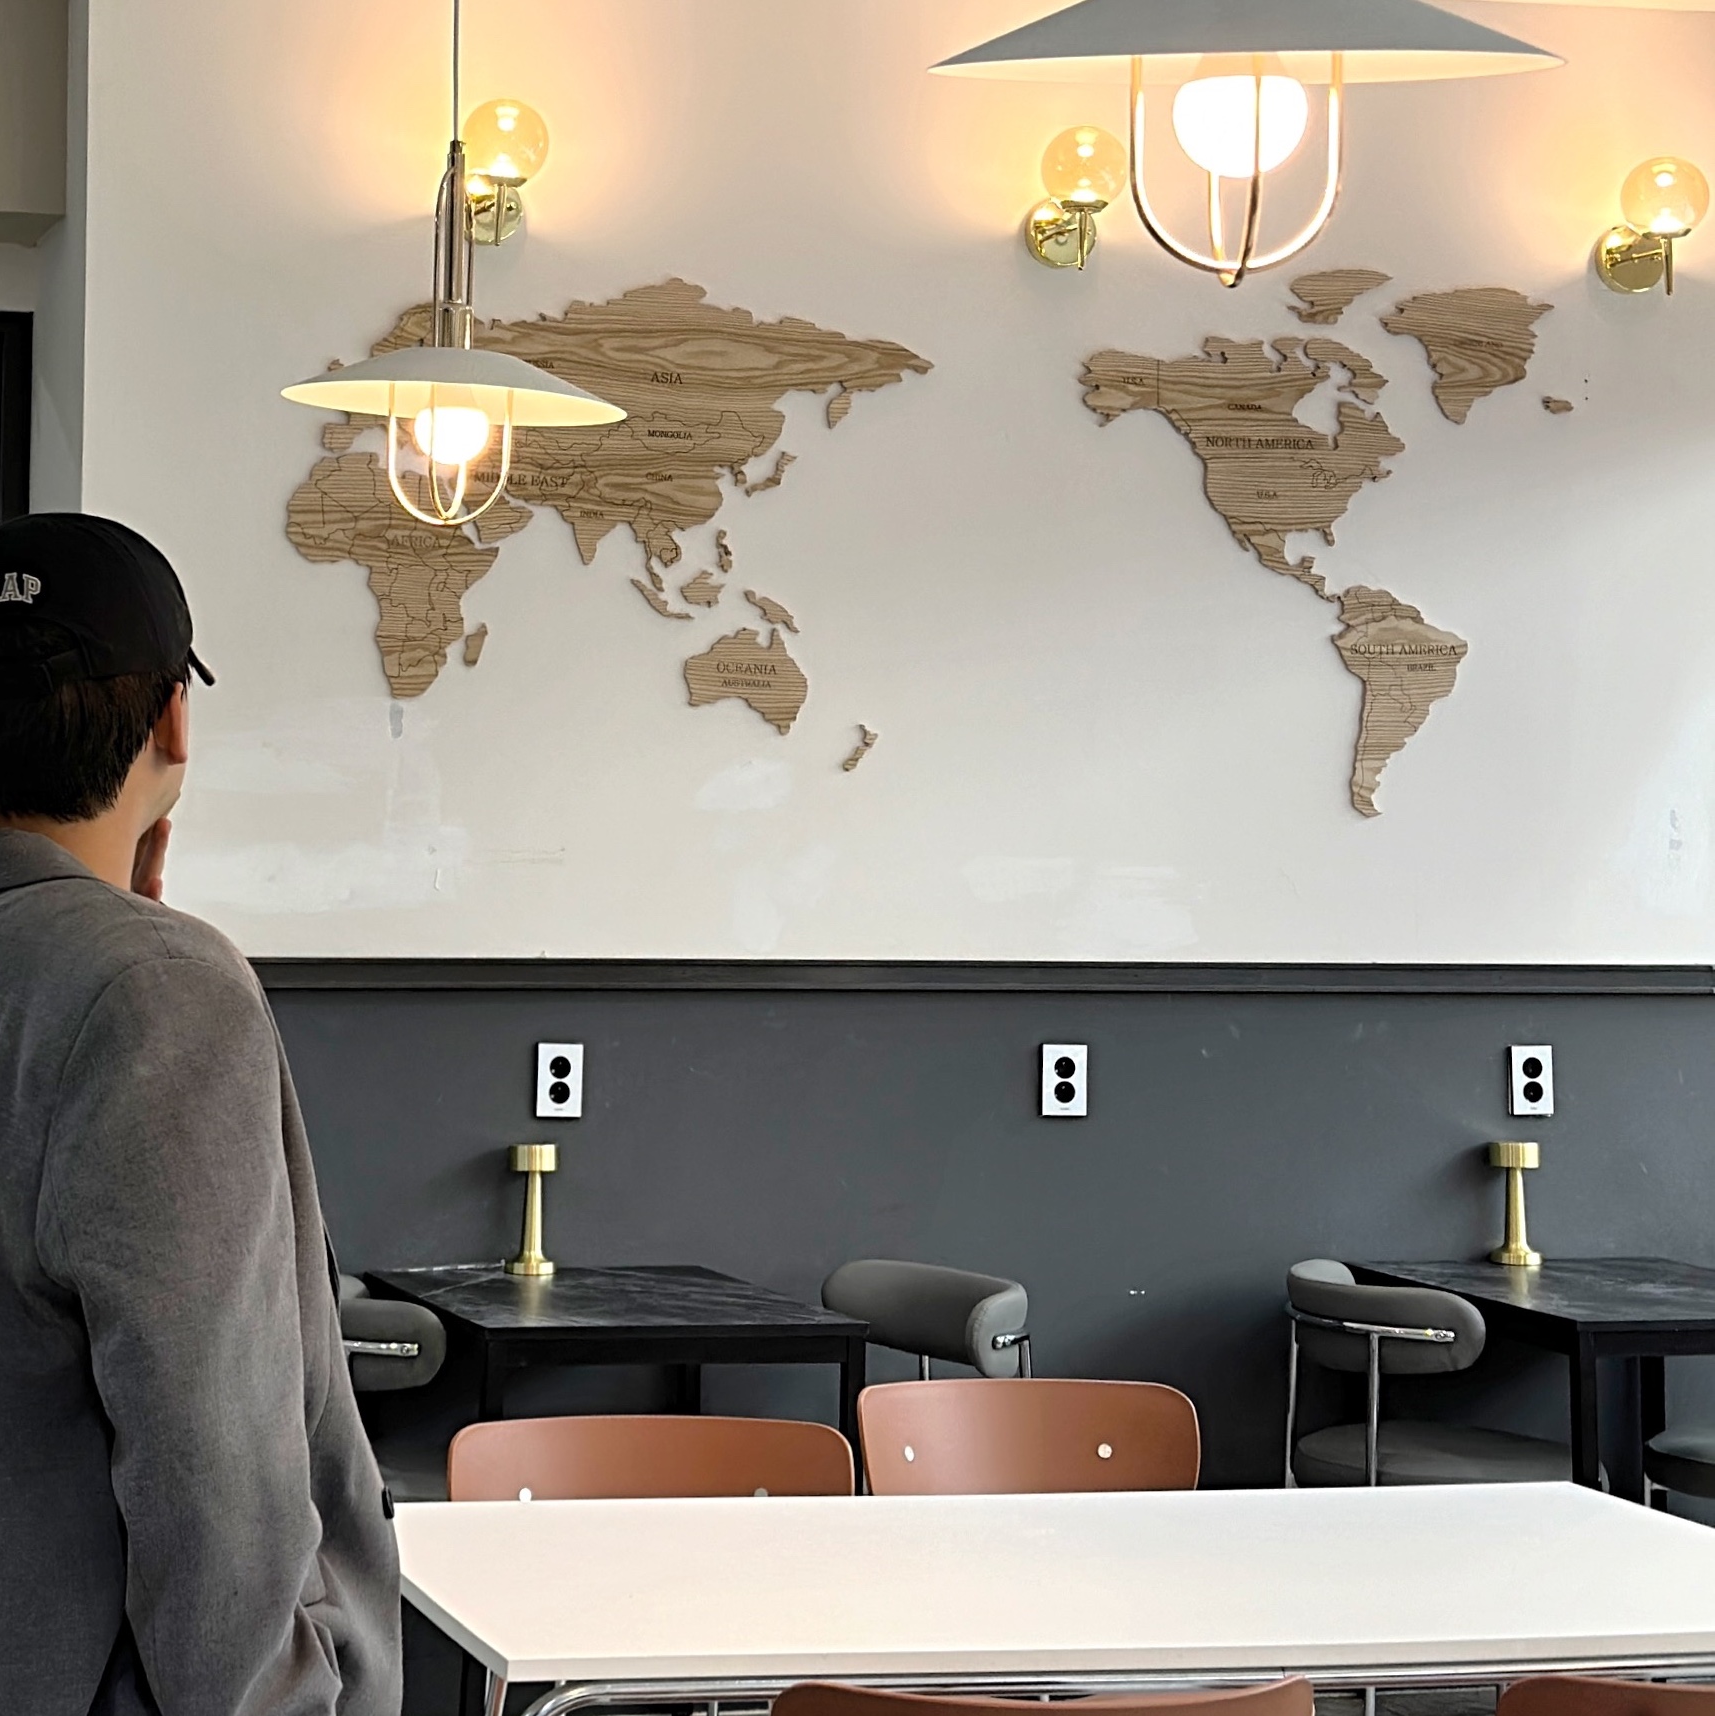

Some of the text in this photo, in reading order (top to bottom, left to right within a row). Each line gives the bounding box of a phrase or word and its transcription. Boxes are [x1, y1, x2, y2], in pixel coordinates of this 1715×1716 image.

[651, 371, 683, 385] ASIA
[1227, 403, 1262, 411] CANADA
[647, 429, 693, 440] MONGOLIA
[1206, 436, 1315, 450] NORTH AMERICA
[531, 474, 567, 488] EAST
[646, 472, 673, 482] CHINA
[391, 534, 441, 549] AFRICA
[1350, 643, 1458, 656] SOUTH AMERICA
[716, 661, 777, 675] OCEANIA
[721, 679, 772, 688] AUSTRALIA
